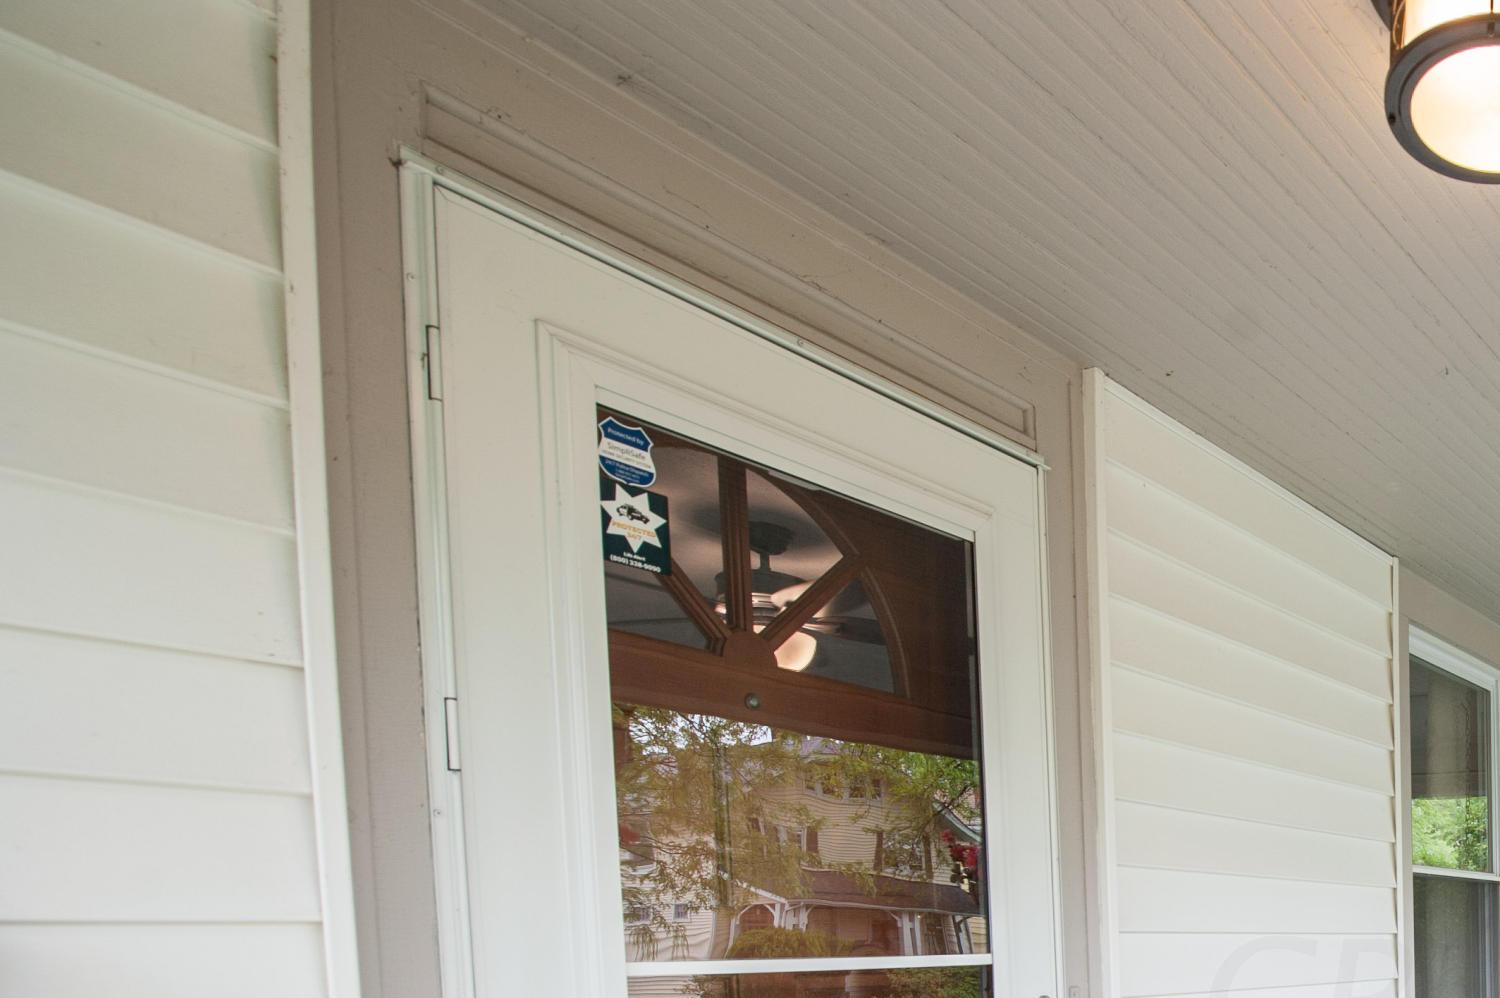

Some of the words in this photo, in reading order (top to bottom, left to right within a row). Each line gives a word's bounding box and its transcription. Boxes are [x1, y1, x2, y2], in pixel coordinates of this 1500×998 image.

[607, 426, 636, 442] Protected
[607, 442, 646, 460] SimpliSafe
[612, 521, 657, 538] PROTECTED
[610, 554, 629, 565] (800)
